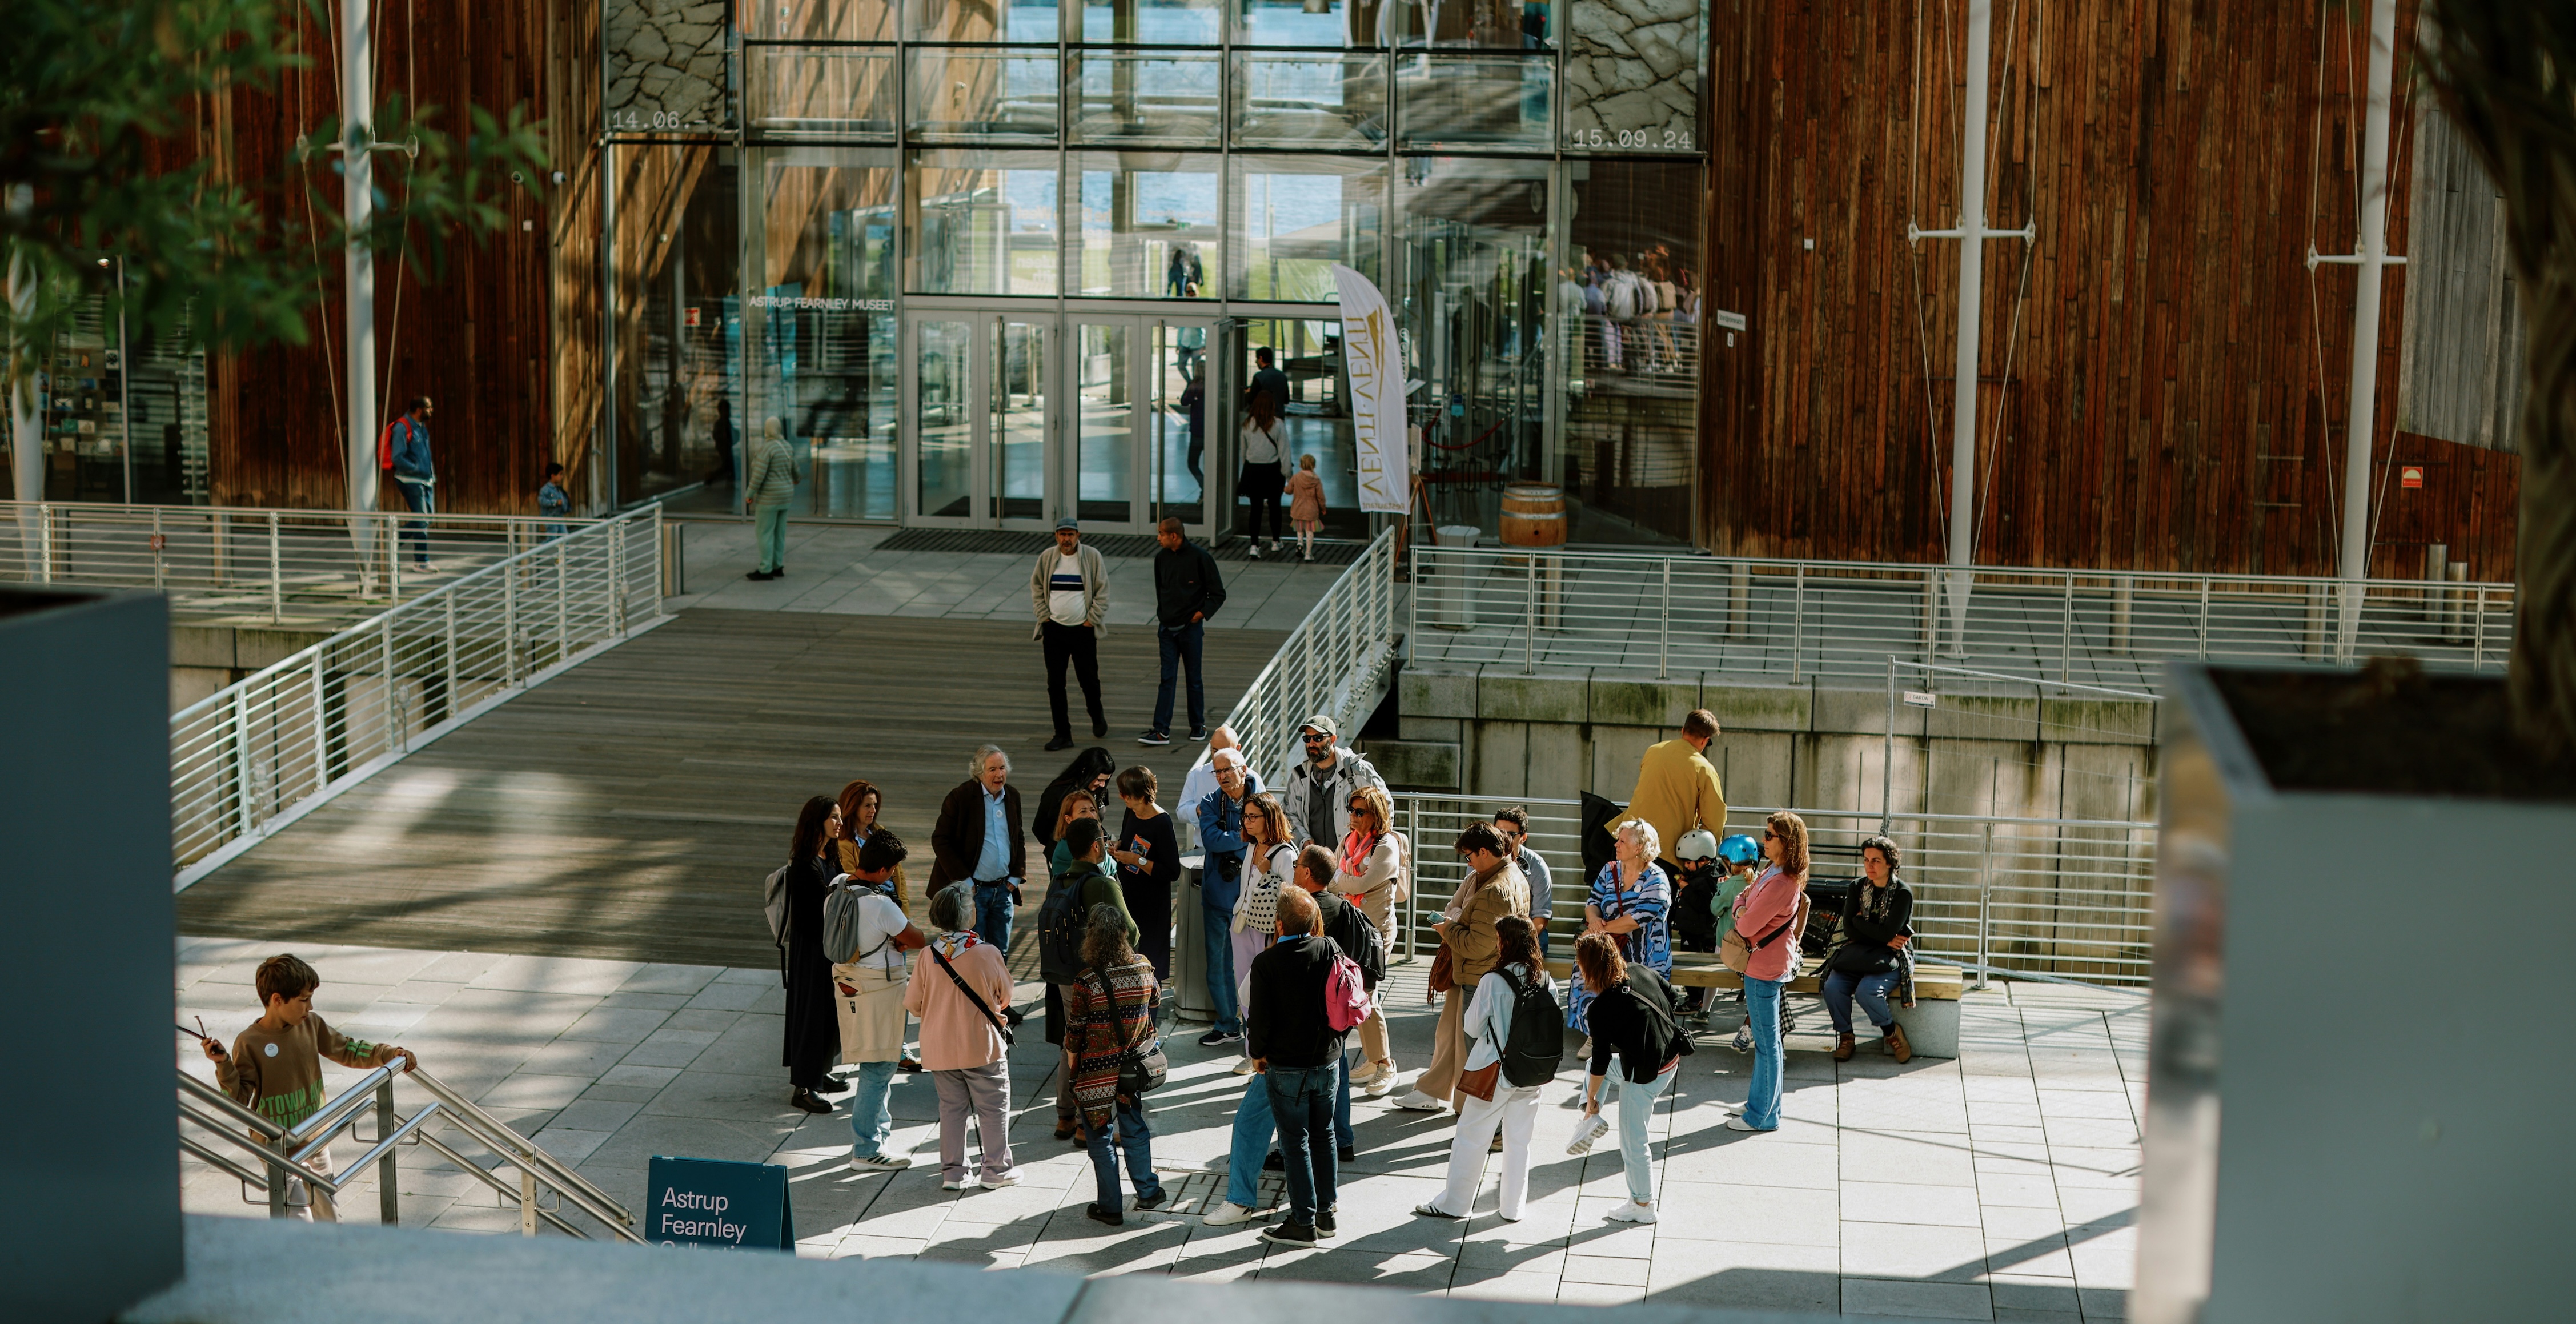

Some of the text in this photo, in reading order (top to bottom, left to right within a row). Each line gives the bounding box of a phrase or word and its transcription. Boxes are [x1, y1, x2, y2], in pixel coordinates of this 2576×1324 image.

[1574, 129, 1692, 149] 15.09.24
[749, 296, 896, 311] ASTRUP FEARNLEY MUSEET
[256, 1087, 307, 1116] PTOWN
[661, 1187, 728, 1215] Astrup
[661, 1213, 747, 1244] Fearnley
